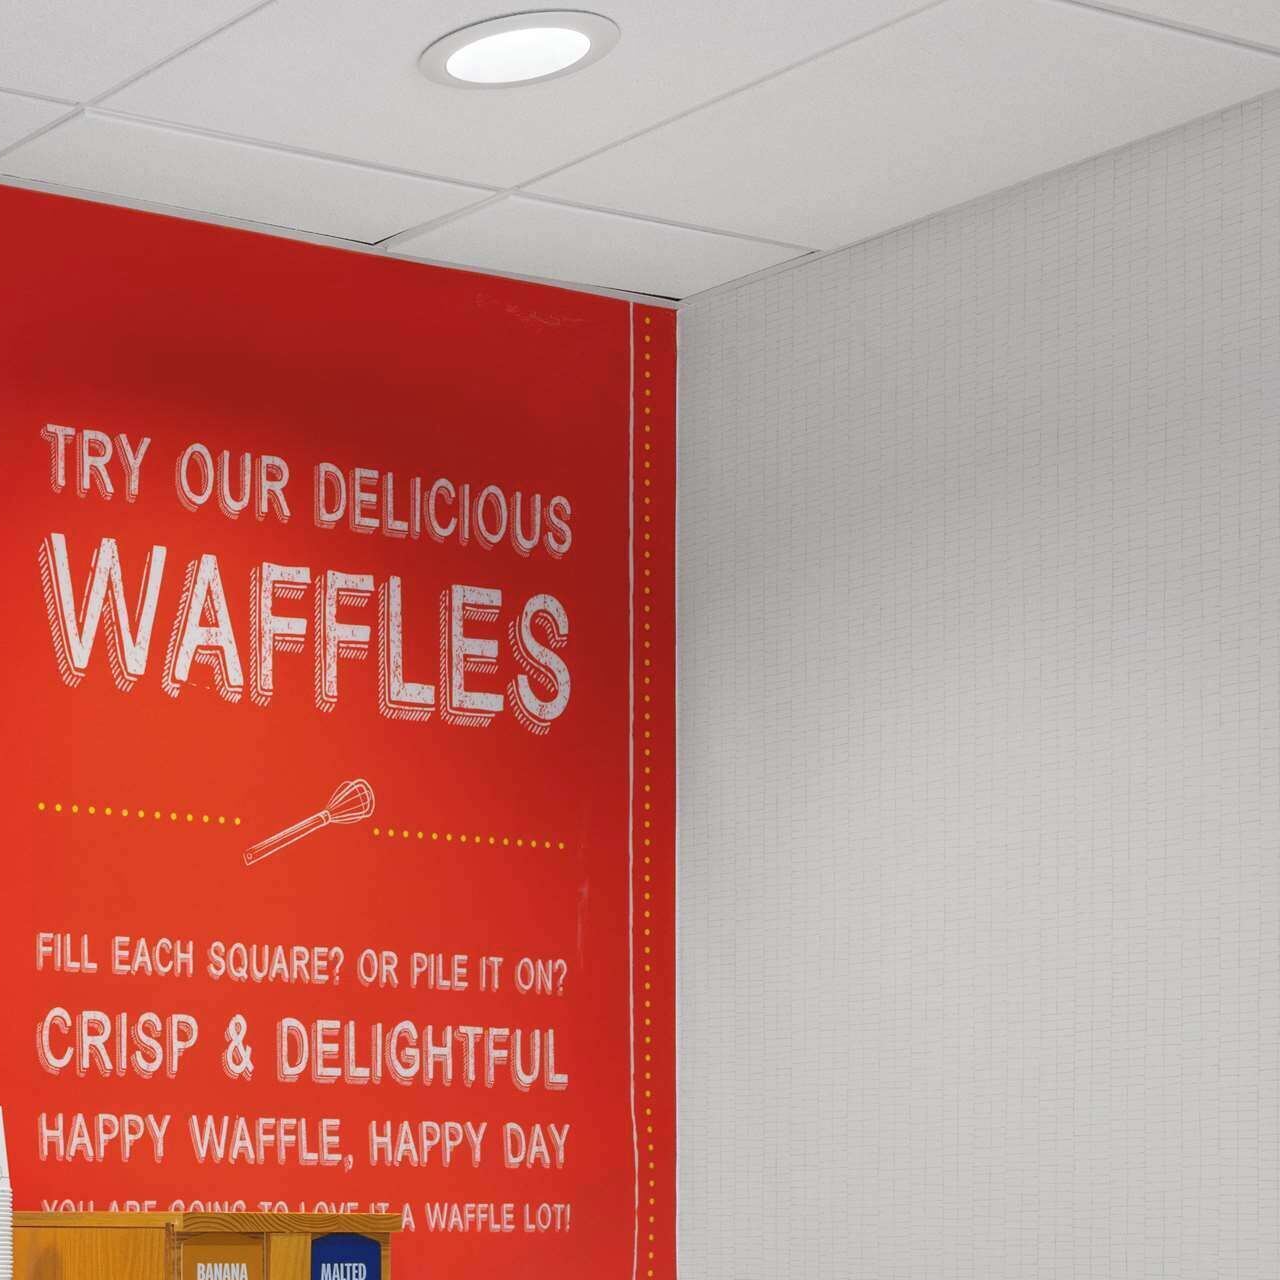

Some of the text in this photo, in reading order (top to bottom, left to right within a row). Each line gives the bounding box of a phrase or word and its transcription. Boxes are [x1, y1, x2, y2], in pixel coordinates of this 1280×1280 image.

[40, 423, 573, 559] TRY OUR DELICIOUS
[38, 532, 571, 735] WAFFLES
[36, 932, 568, 996] FILL EACH SQUARE? OR PILE IT ON?
[36, 1006, 569, 1092] CRISP & DELIGHTFUL
[39, 1112, 570, 1172] HAPPY WAFFLE, HAPPY DAY
[401, 1202, 415, 1232] A
[425, 1202, 514, 1232] WAFFLE
[524, 1202, 572, 1232] LOT!
